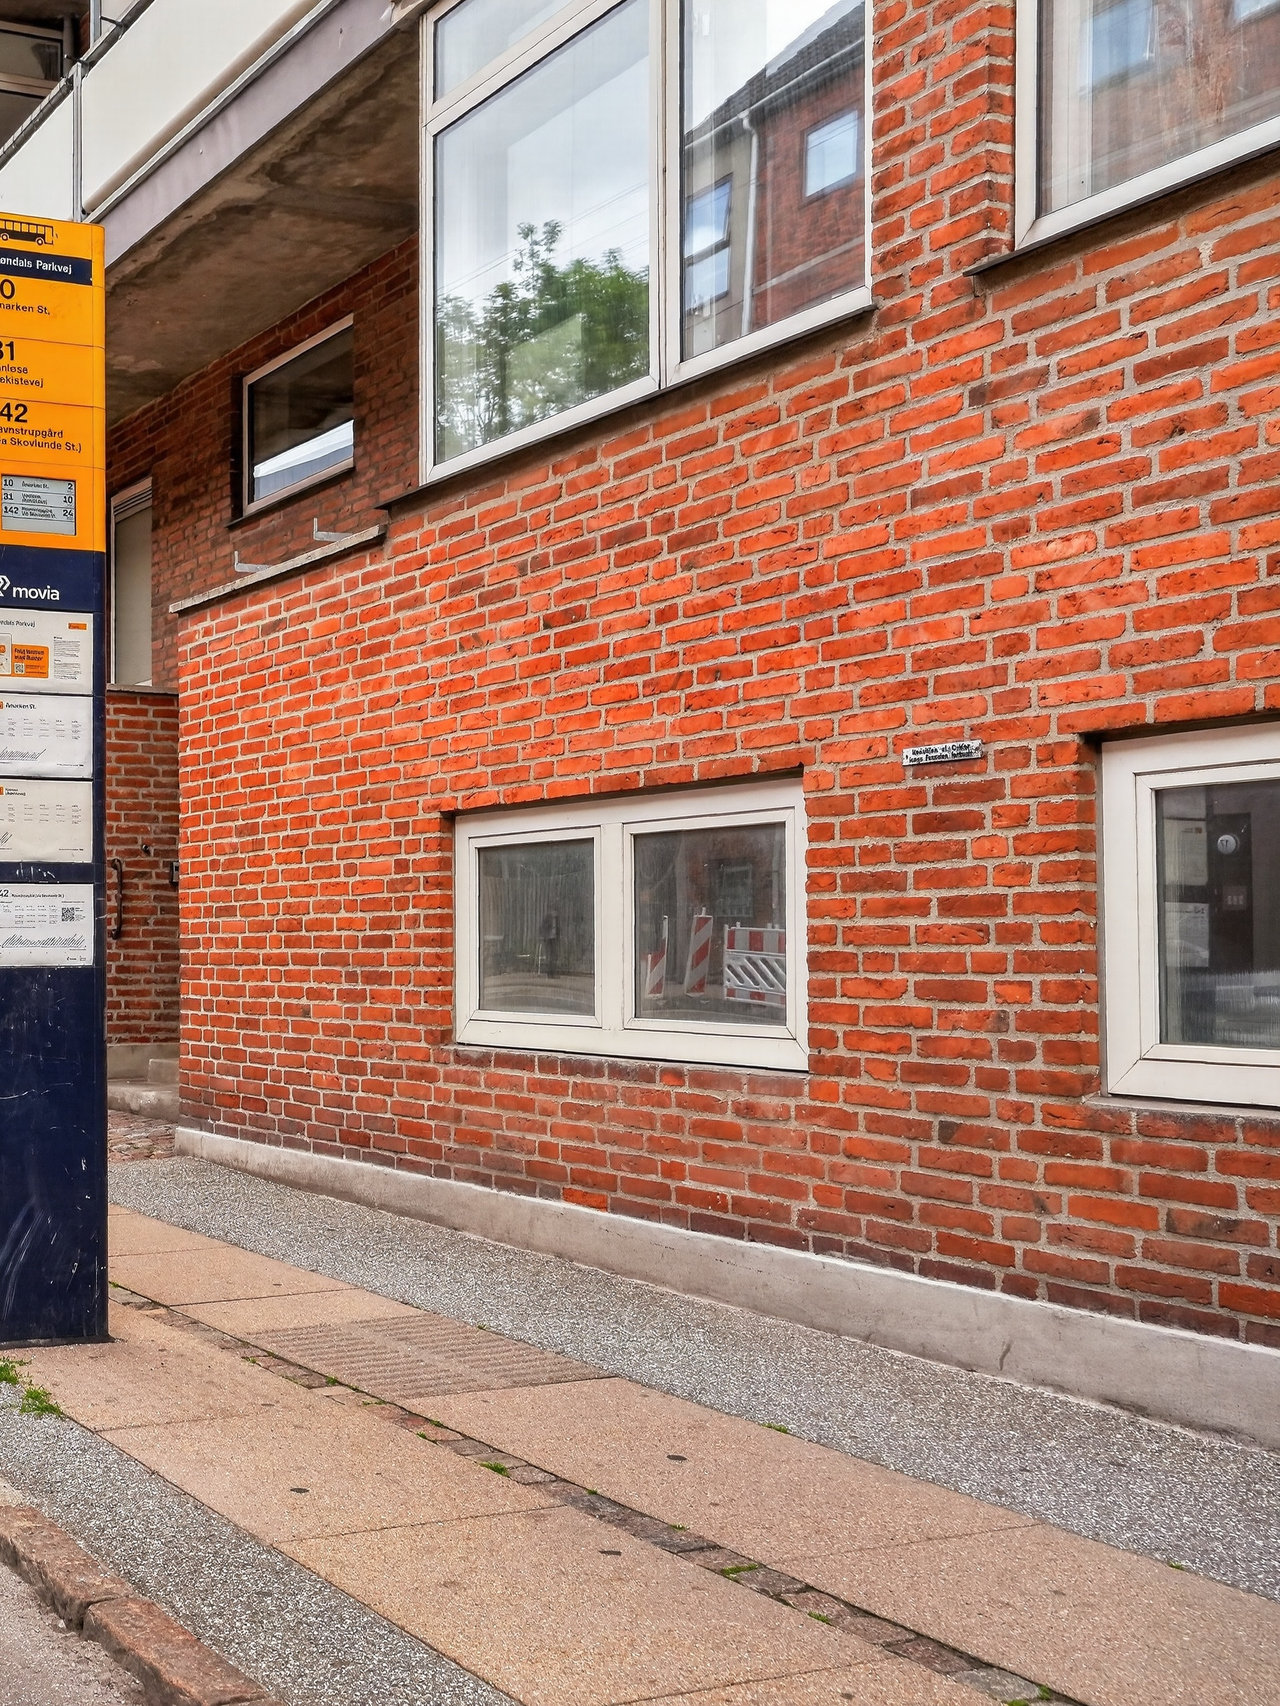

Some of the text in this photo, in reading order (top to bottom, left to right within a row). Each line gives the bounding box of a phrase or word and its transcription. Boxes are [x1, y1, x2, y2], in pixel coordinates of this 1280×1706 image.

[36, 260, 72, 275] Parkvej
[37, 305, 50, 315] St.
[10, 437, 62, 450] Skovlunde
[65, 442, 82, 453] St.)
[3, 479, 14, 487] 10
[3, 493, 14, 501] 31
[63, 496, 73, 504] 10
[3, 506, 19, 514] 142
[12, 585, 60, 601] movia
